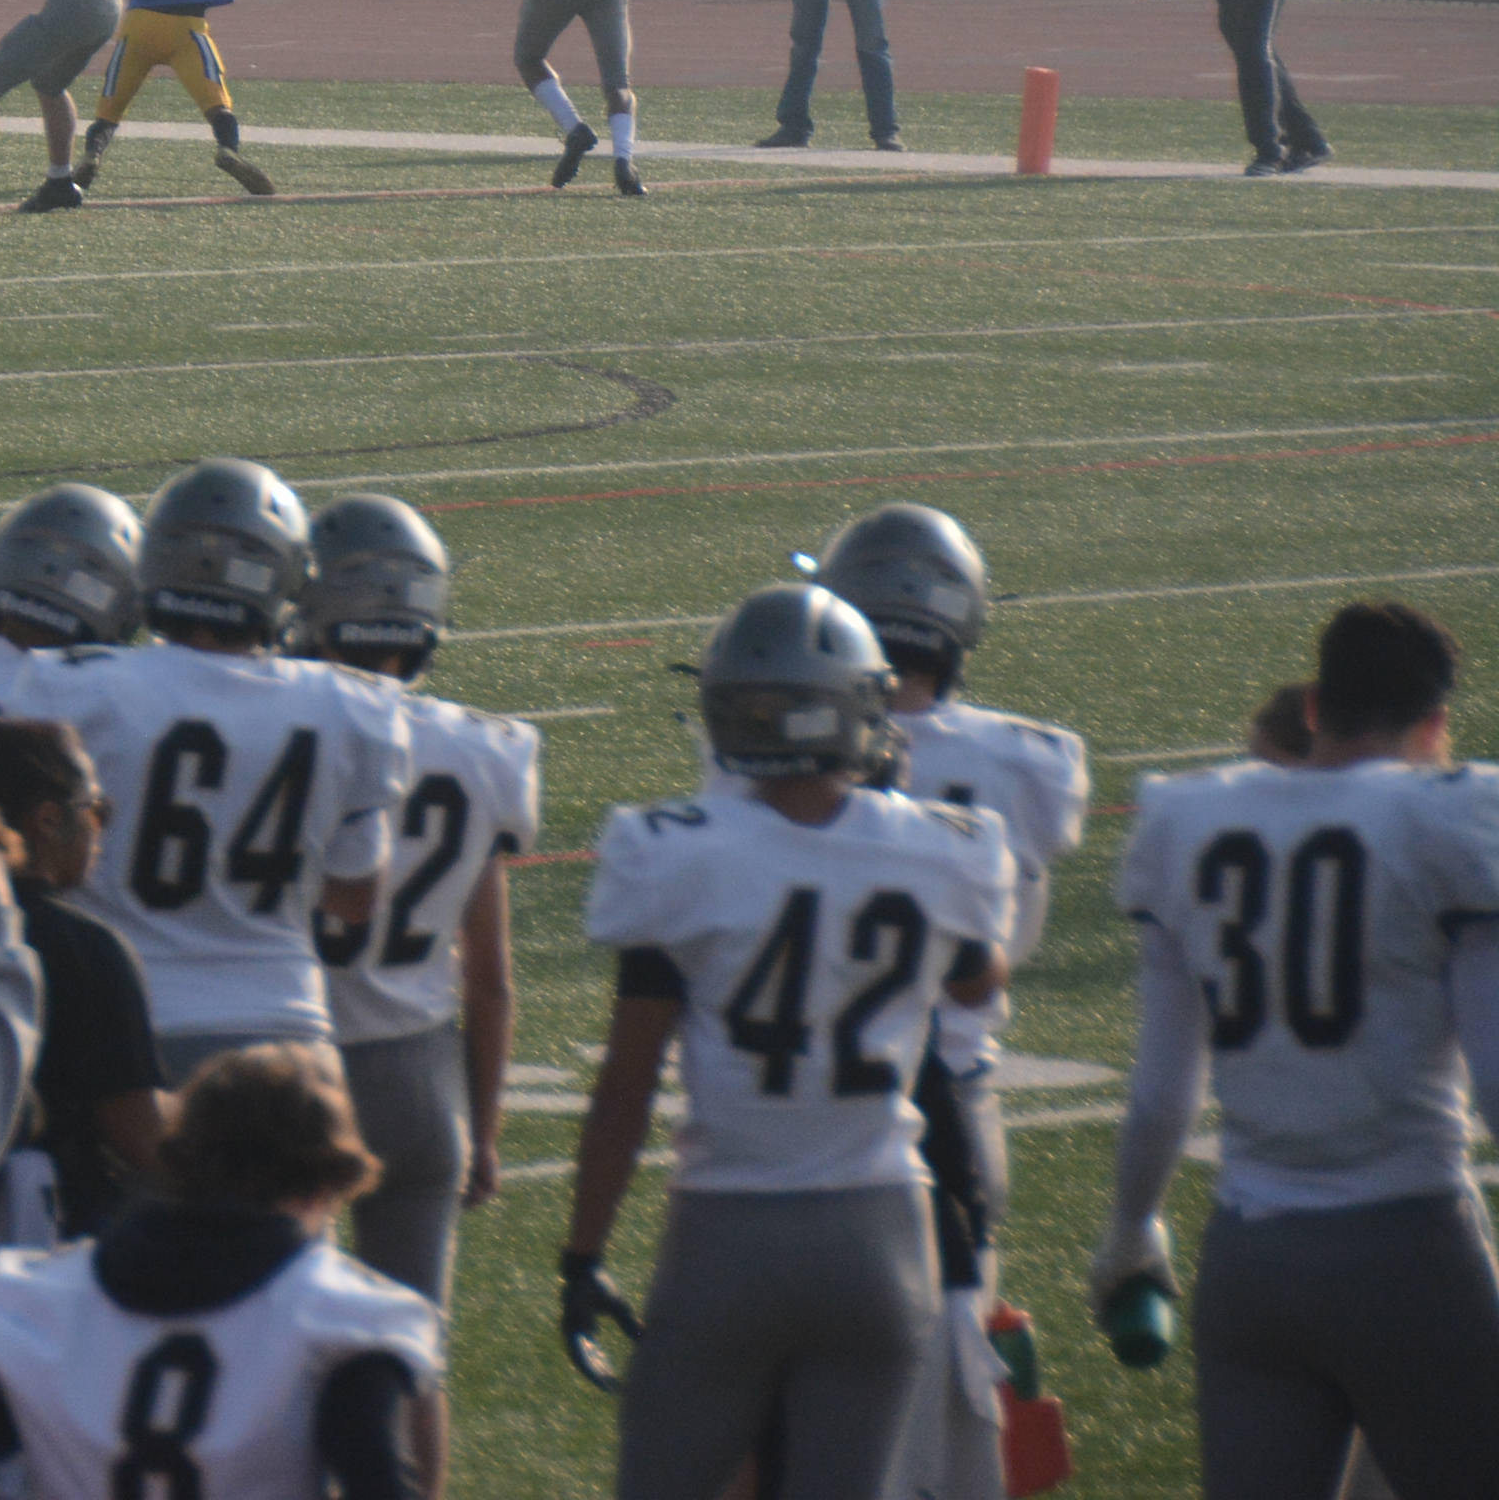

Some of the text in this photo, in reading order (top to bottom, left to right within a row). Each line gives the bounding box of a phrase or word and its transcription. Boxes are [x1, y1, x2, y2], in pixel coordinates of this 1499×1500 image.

[130, 717, 319, 913] 64
[726, 887, 930, 1096] 42
[1197, 826, 1368, 1049] 30
